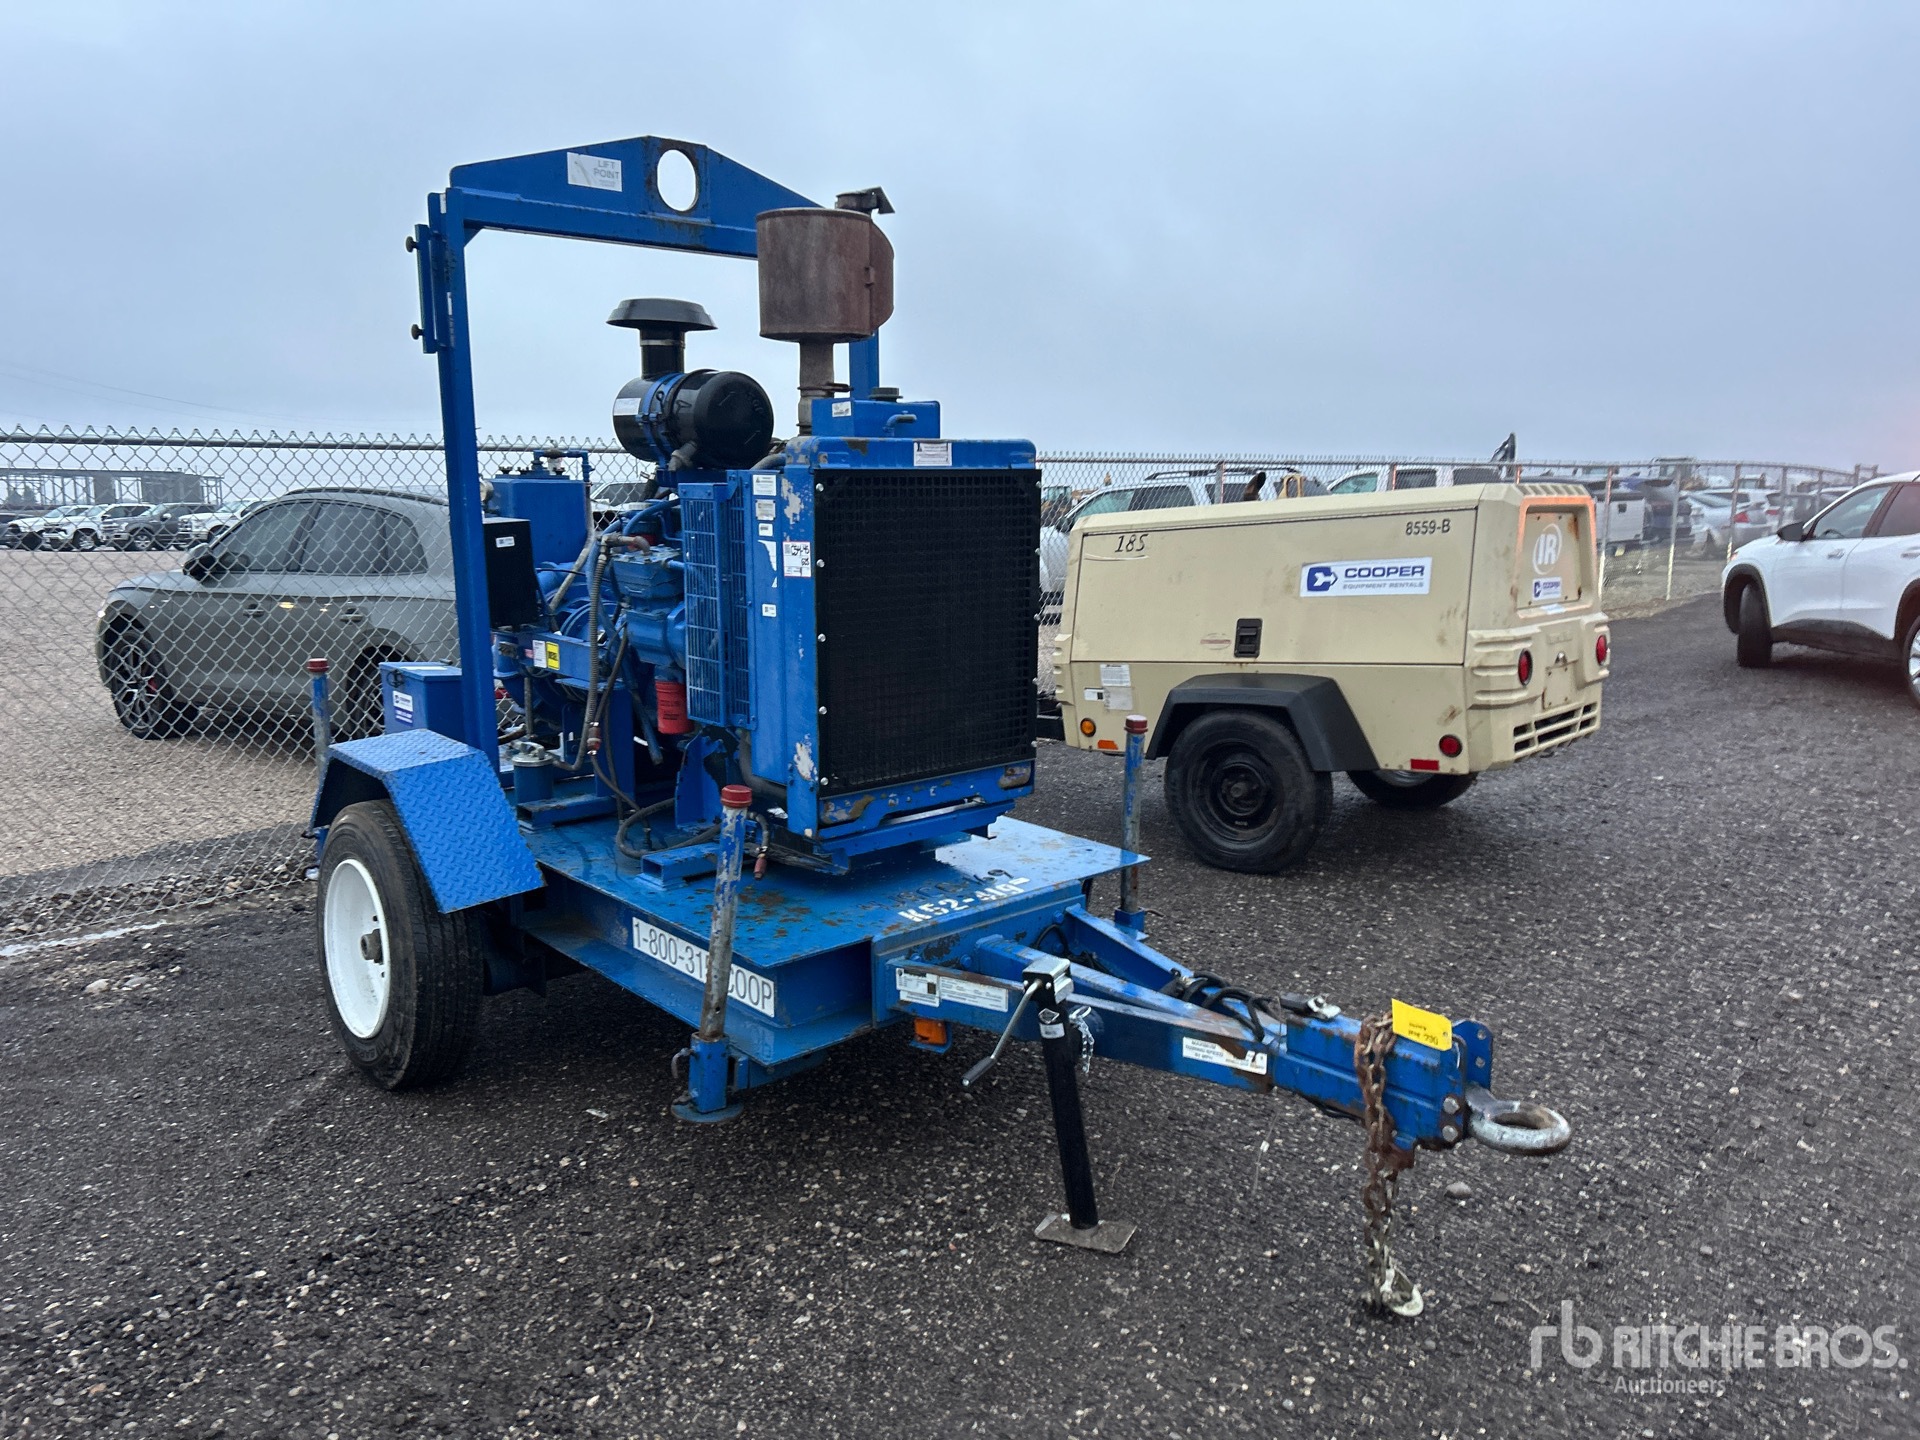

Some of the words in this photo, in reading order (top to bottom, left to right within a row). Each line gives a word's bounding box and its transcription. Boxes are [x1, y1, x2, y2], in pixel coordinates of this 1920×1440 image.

[593, 167, 620, 179] POINT
[1405, 518, 1451, 536] 8559-B
[1114, 533, 1149, 553] 185
[1537, 533, 1558, 565] IR
[1344, 565, 1425, 579] COOPER
[1342, 582, 1386, 590] EQUIPMENT
[1389, 581, 1424, 589] RENTALS
